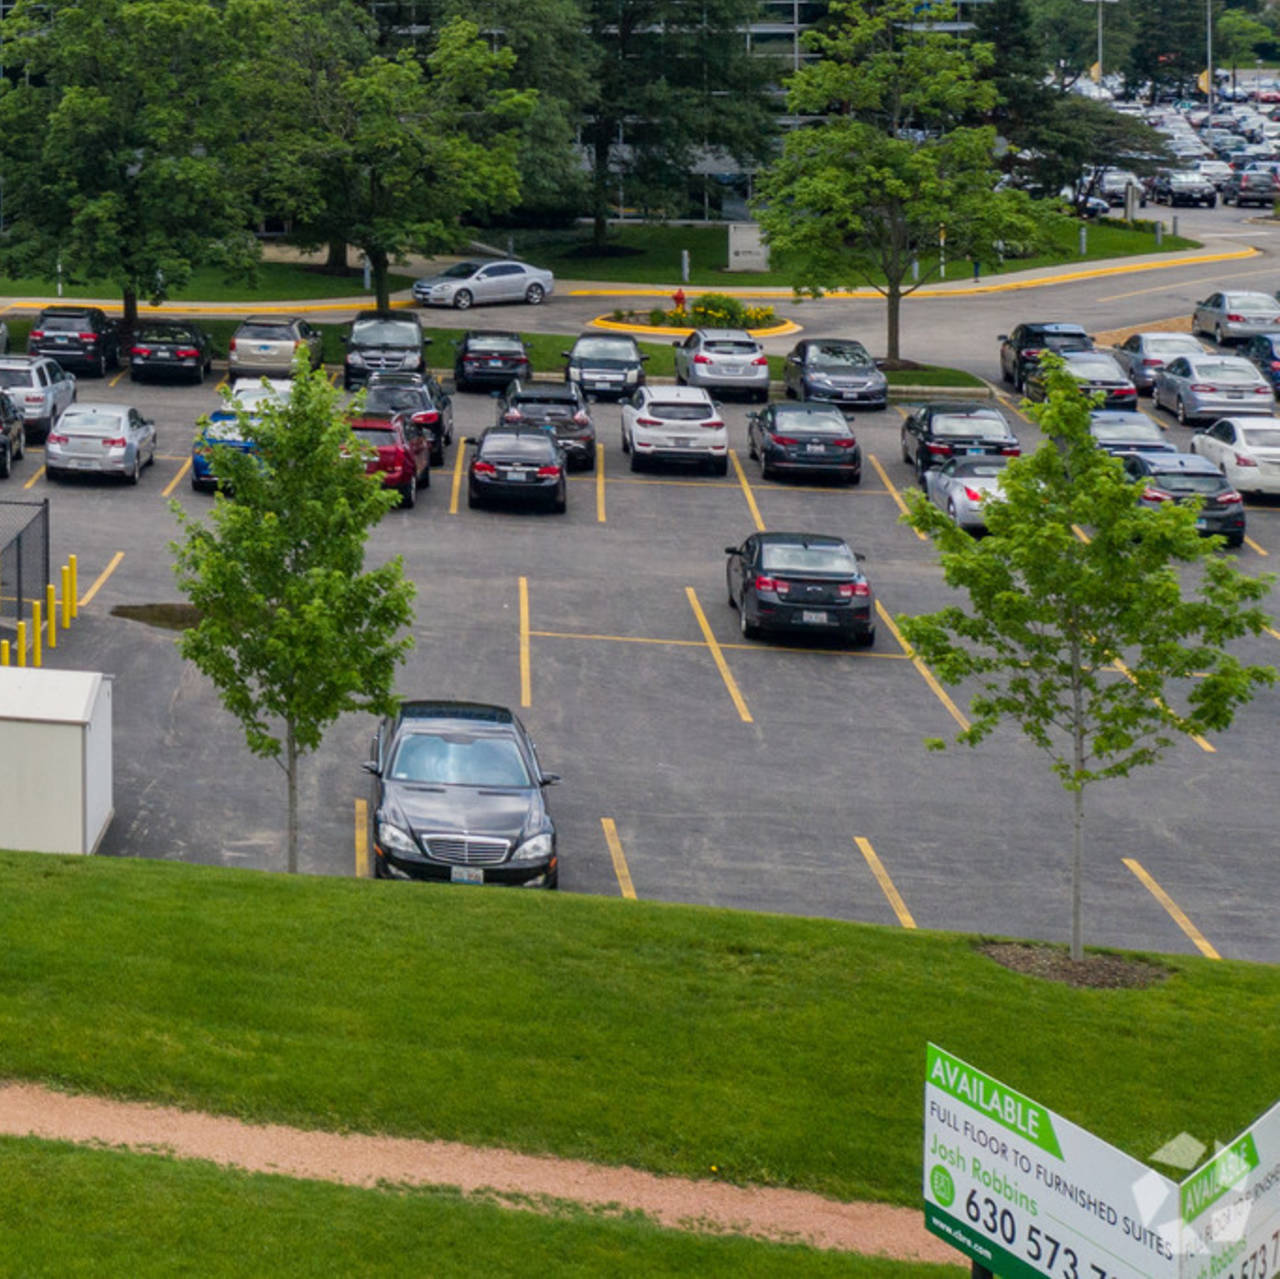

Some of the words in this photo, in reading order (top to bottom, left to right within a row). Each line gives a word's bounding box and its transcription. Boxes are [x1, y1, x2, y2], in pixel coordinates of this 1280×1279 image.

[931, 1057, 1040, 1139] AVAILABLE
[930, 1132, 966, 1172] Josh
[971, 1157, 1038, 1217] Robbins
[930, 1100, 959, 1132] FULL
[964, 1120, 1009, 1161] FLOOR
[1012, 1148, 1032, 1174] TO
[1036, 1164, 1118, 1226] FURNISHED
[1122, 1216, 1174, 1261] SUITES
[966, 1189, 1016, 1245] 630
[1026, 1224, 1079, 1279] 573
